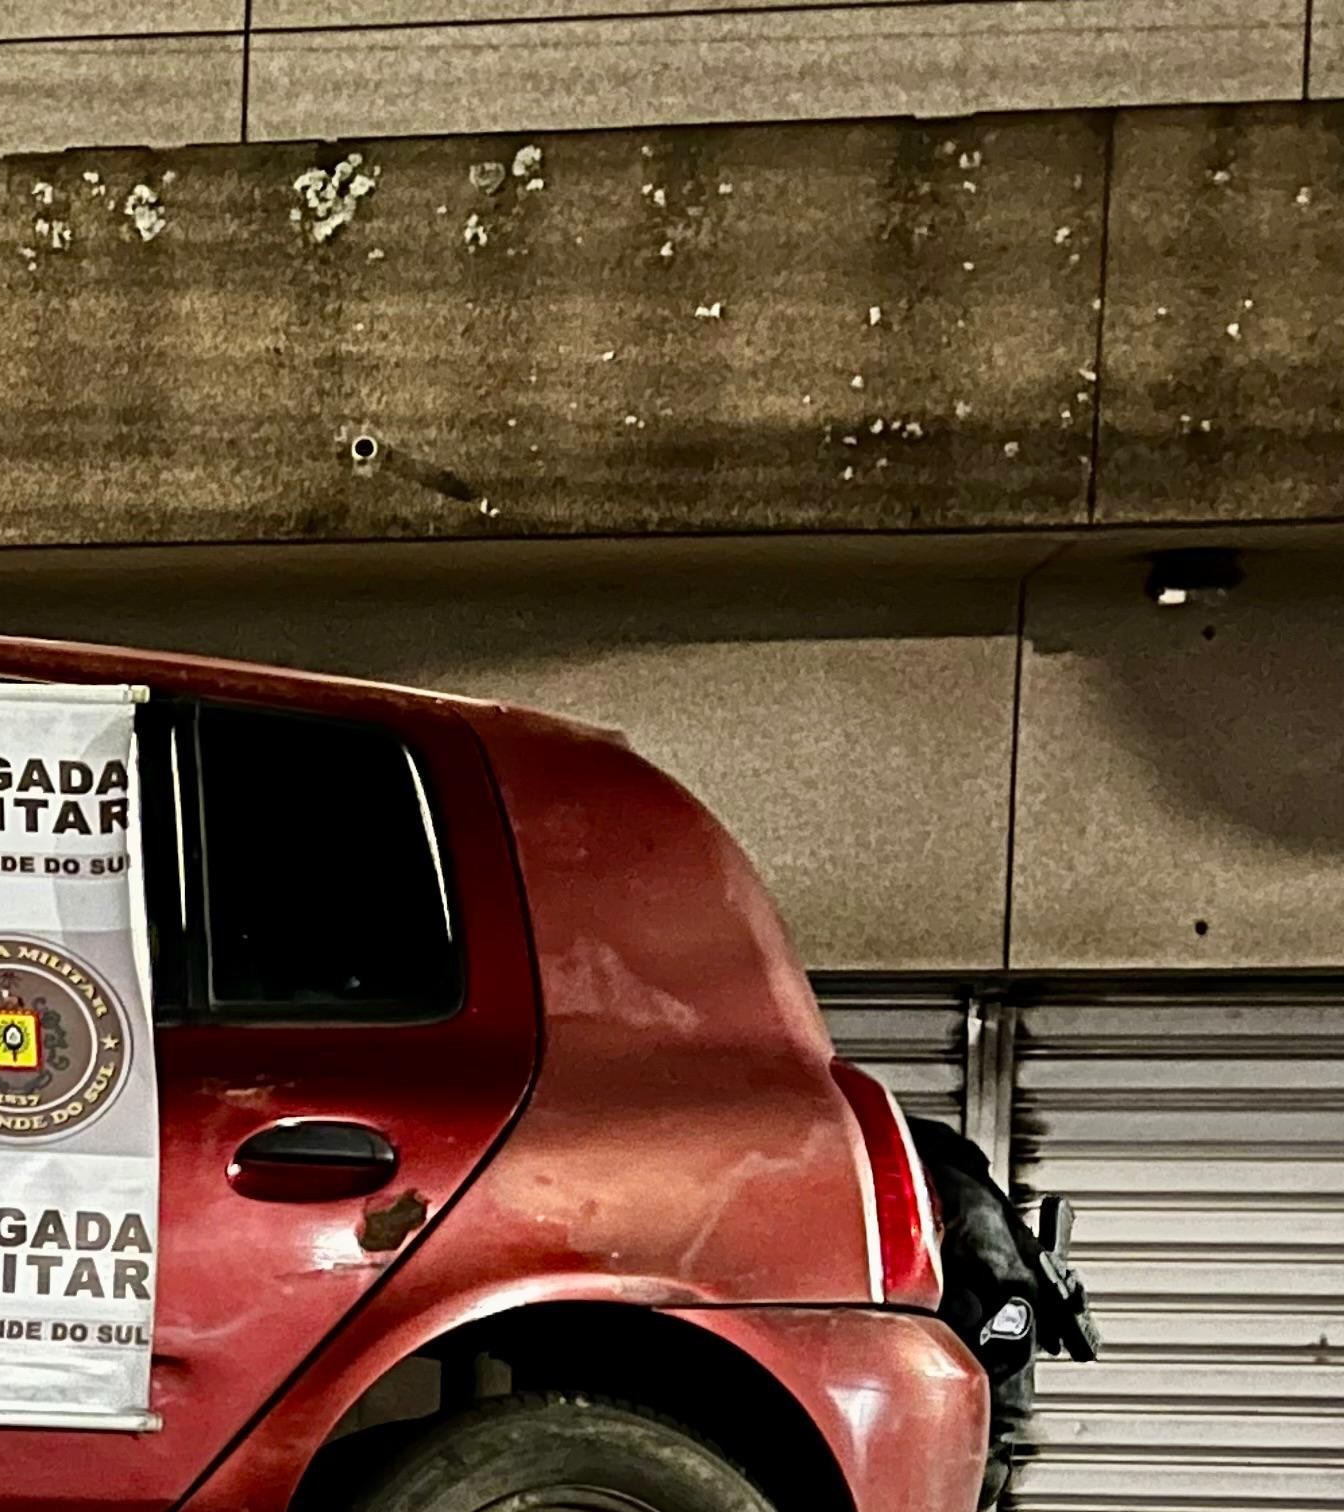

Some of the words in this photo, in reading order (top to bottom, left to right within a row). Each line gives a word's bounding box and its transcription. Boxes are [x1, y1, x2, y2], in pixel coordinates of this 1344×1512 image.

[44, 858, 80, 875] DO
[18, 946, 108, 1018] MILITAR
[51, 1102, 83, 1124] DO
[83, 1062, 115, 1103] SUL
[51, 1323, 88, 1342] DO
[97, 1324, 150, 1345] SUL
